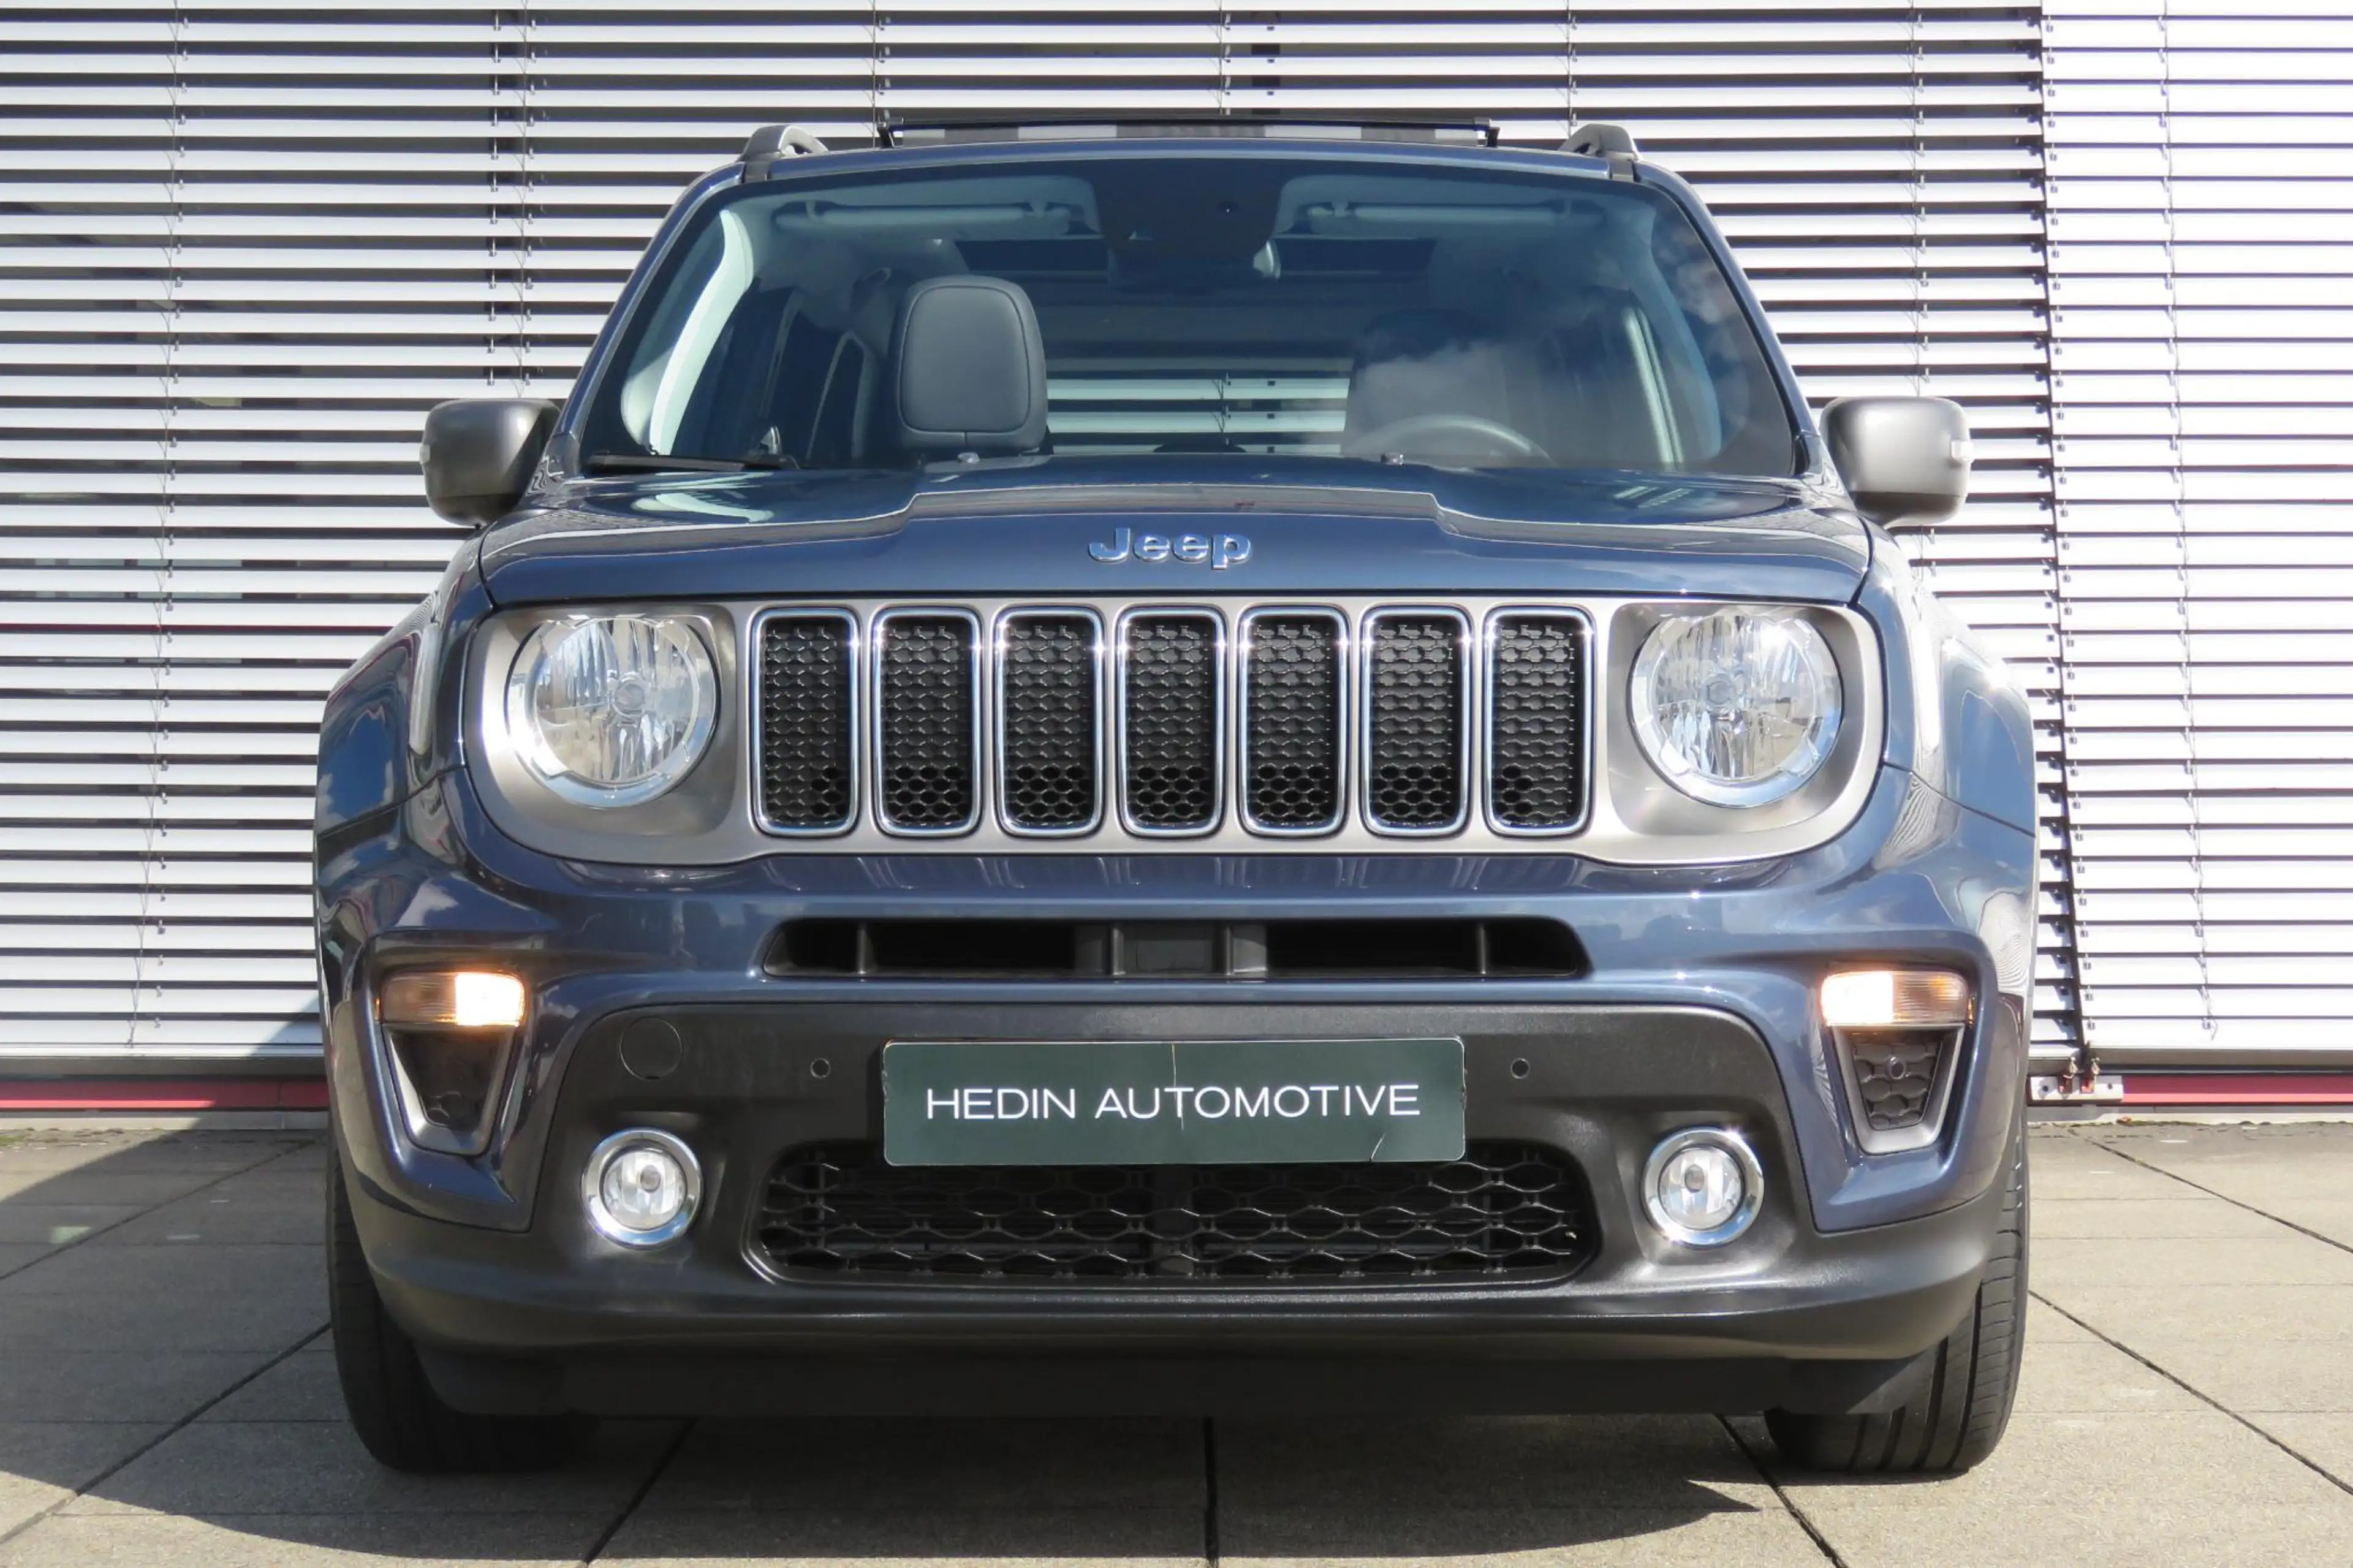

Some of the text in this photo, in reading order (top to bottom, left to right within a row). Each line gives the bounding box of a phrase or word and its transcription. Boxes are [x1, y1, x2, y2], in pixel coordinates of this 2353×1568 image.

[1089, 527, 1251, 570] Jeep
[926, 1083, 1421, 1120] HEDIN AUTOMOTIVE
